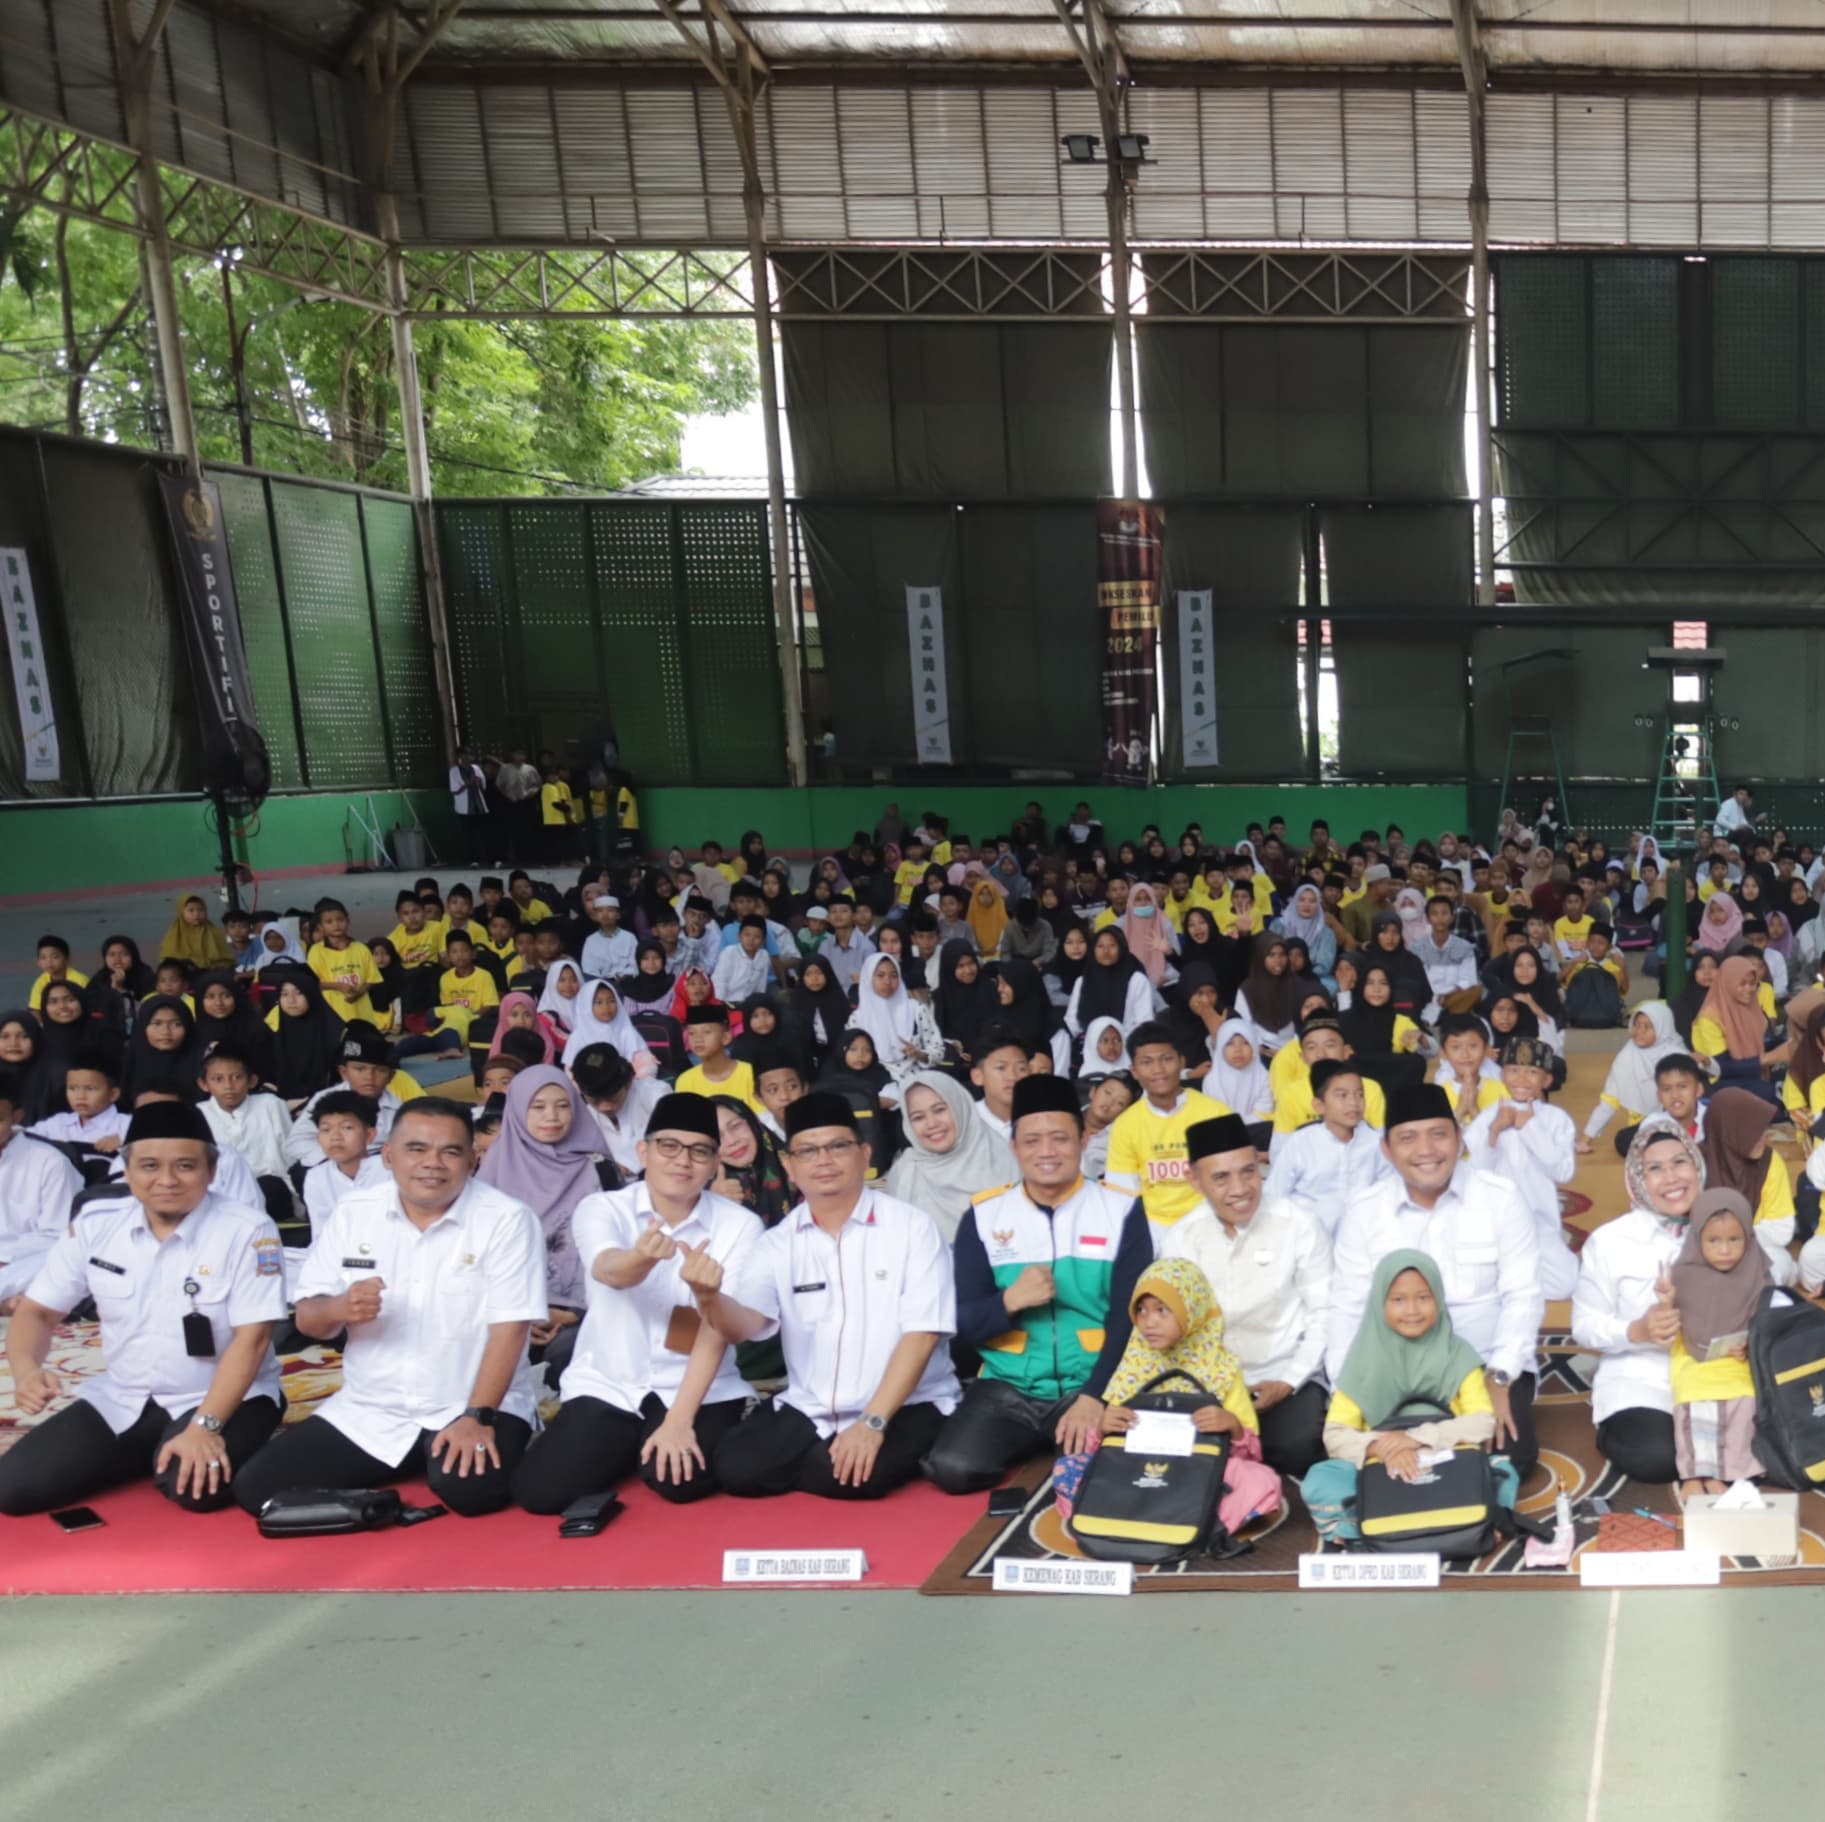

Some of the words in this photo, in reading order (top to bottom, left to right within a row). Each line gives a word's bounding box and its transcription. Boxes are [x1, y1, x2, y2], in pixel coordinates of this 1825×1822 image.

[7, 556, 42, 714] BAZNAS
[919, 594, 937, 714] BAZNAS
[1107, 636, 1143, 653] 2024
[1190, 597, 1206, 716] BAZNAS
[1022, 1566, 1062, 1584] KEMENAG
[1064, 1568, 1081, 1585] KAB
[1083, 1569, 1117, 1586] SERANG
